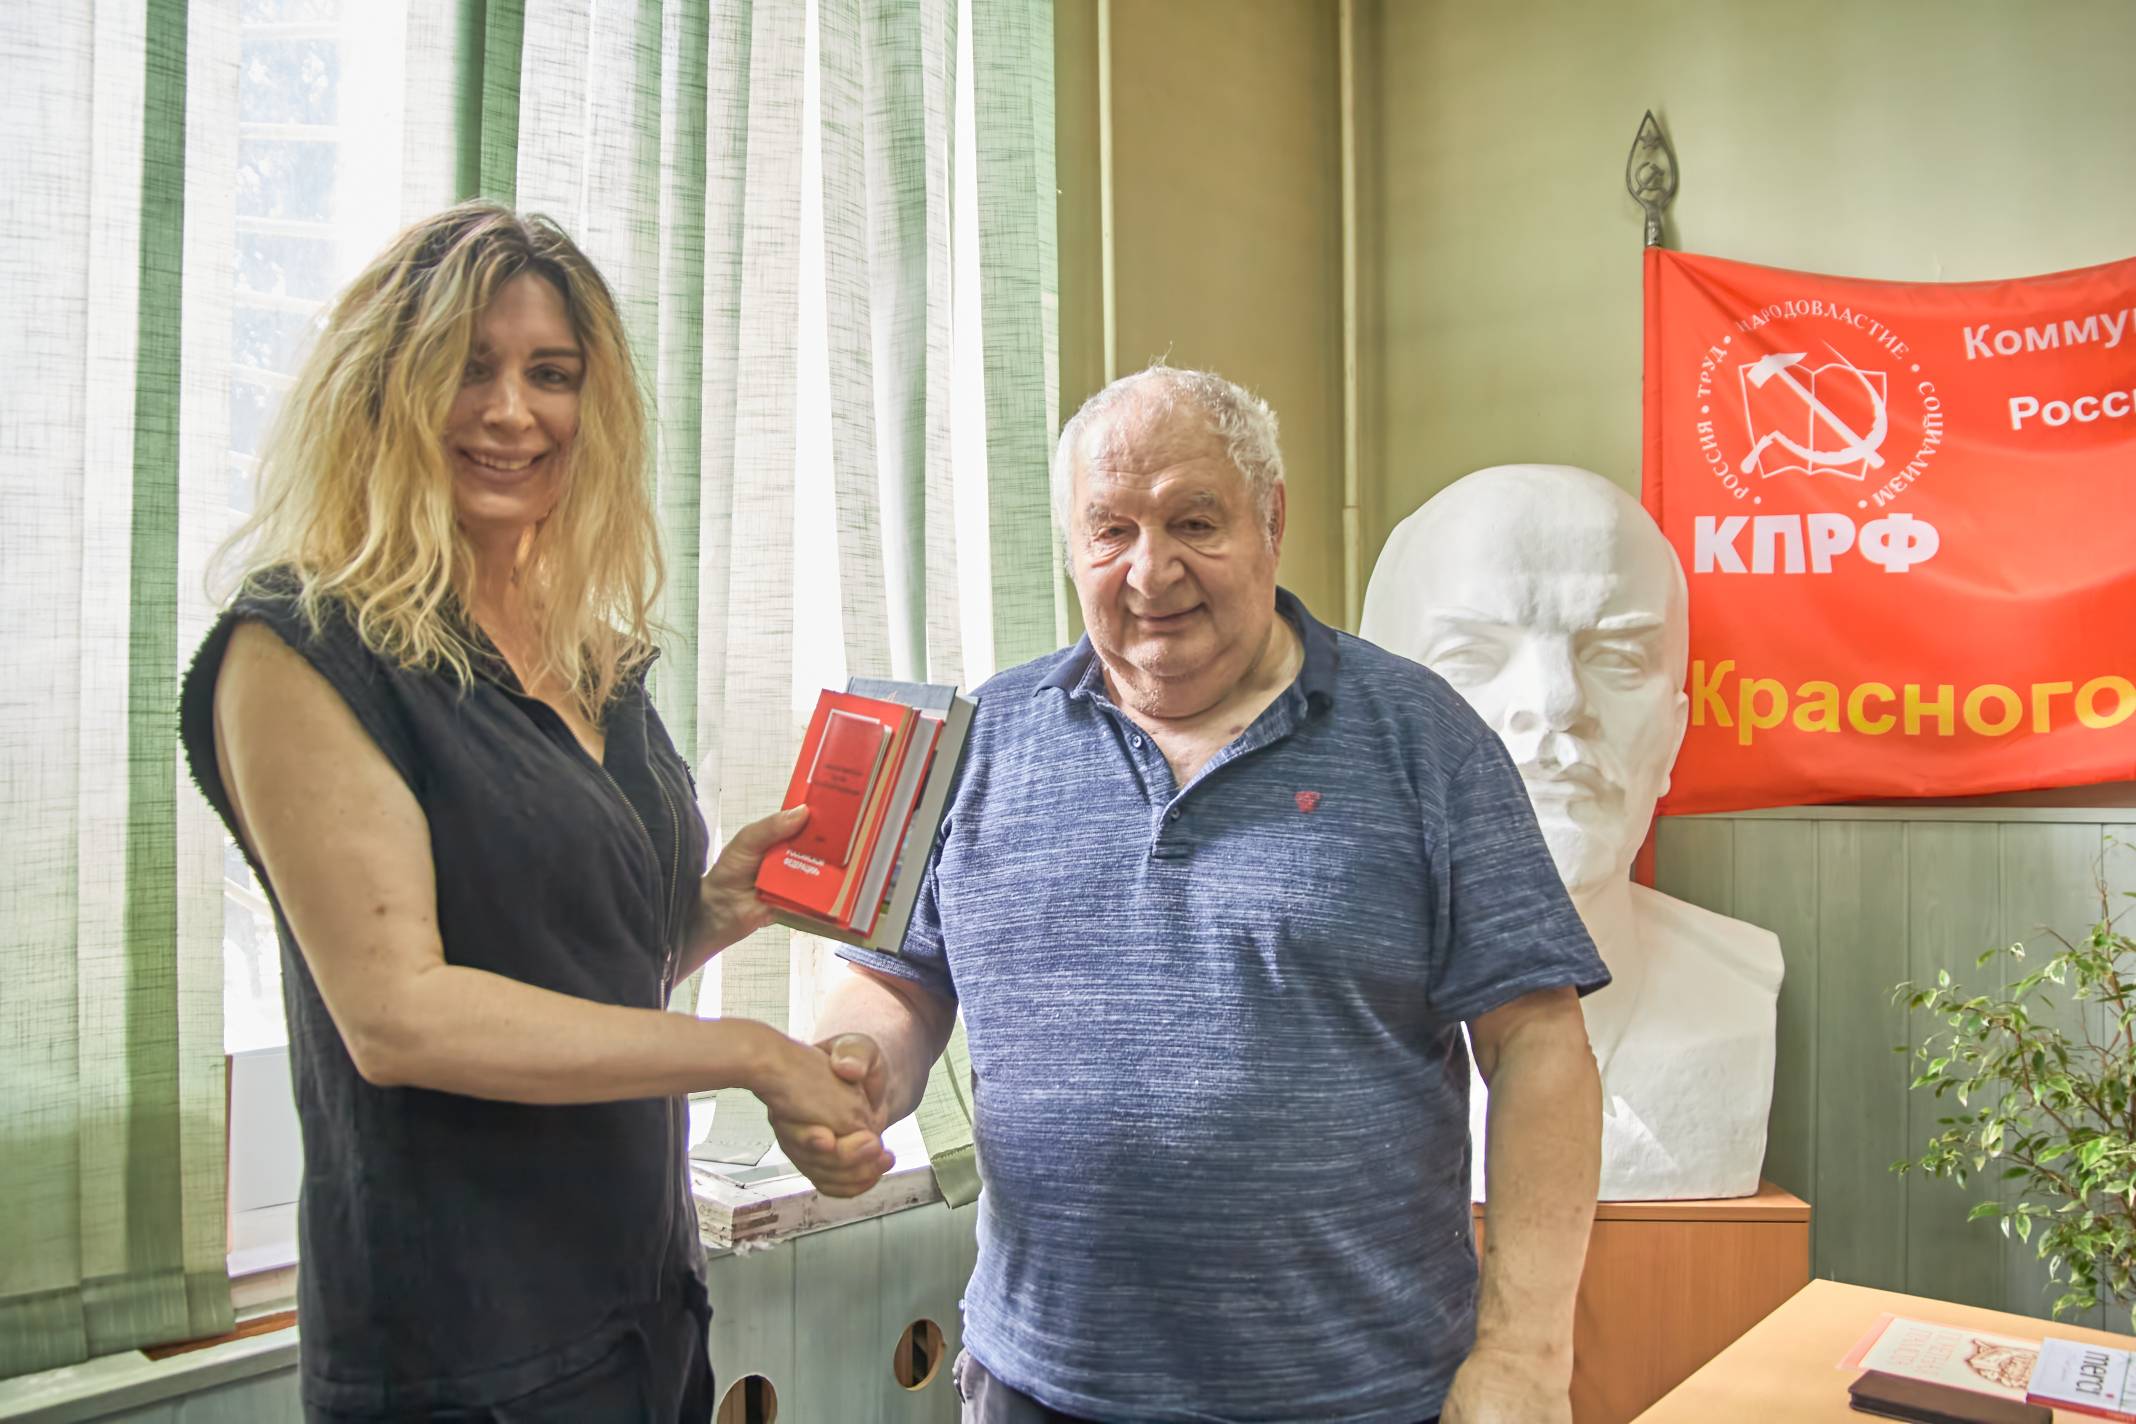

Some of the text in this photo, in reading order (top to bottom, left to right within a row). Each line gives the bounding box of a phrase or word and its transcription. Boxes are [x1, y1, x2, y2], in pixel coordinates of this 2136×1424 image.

[1963, 308, 2136, 360] Комму
[1697, 299, 1943, 507] РОССИЯ ТРУД НАРОДОВЛАСТИЕ СОЦИАЛИЗМ
[2009, 388, 2136, 430] Росс
[1694, 512, 1939, 574] КПРФ
[1692, 659, 2136, 746] Красного
[2076, 1350, 2114, 1399] merci
